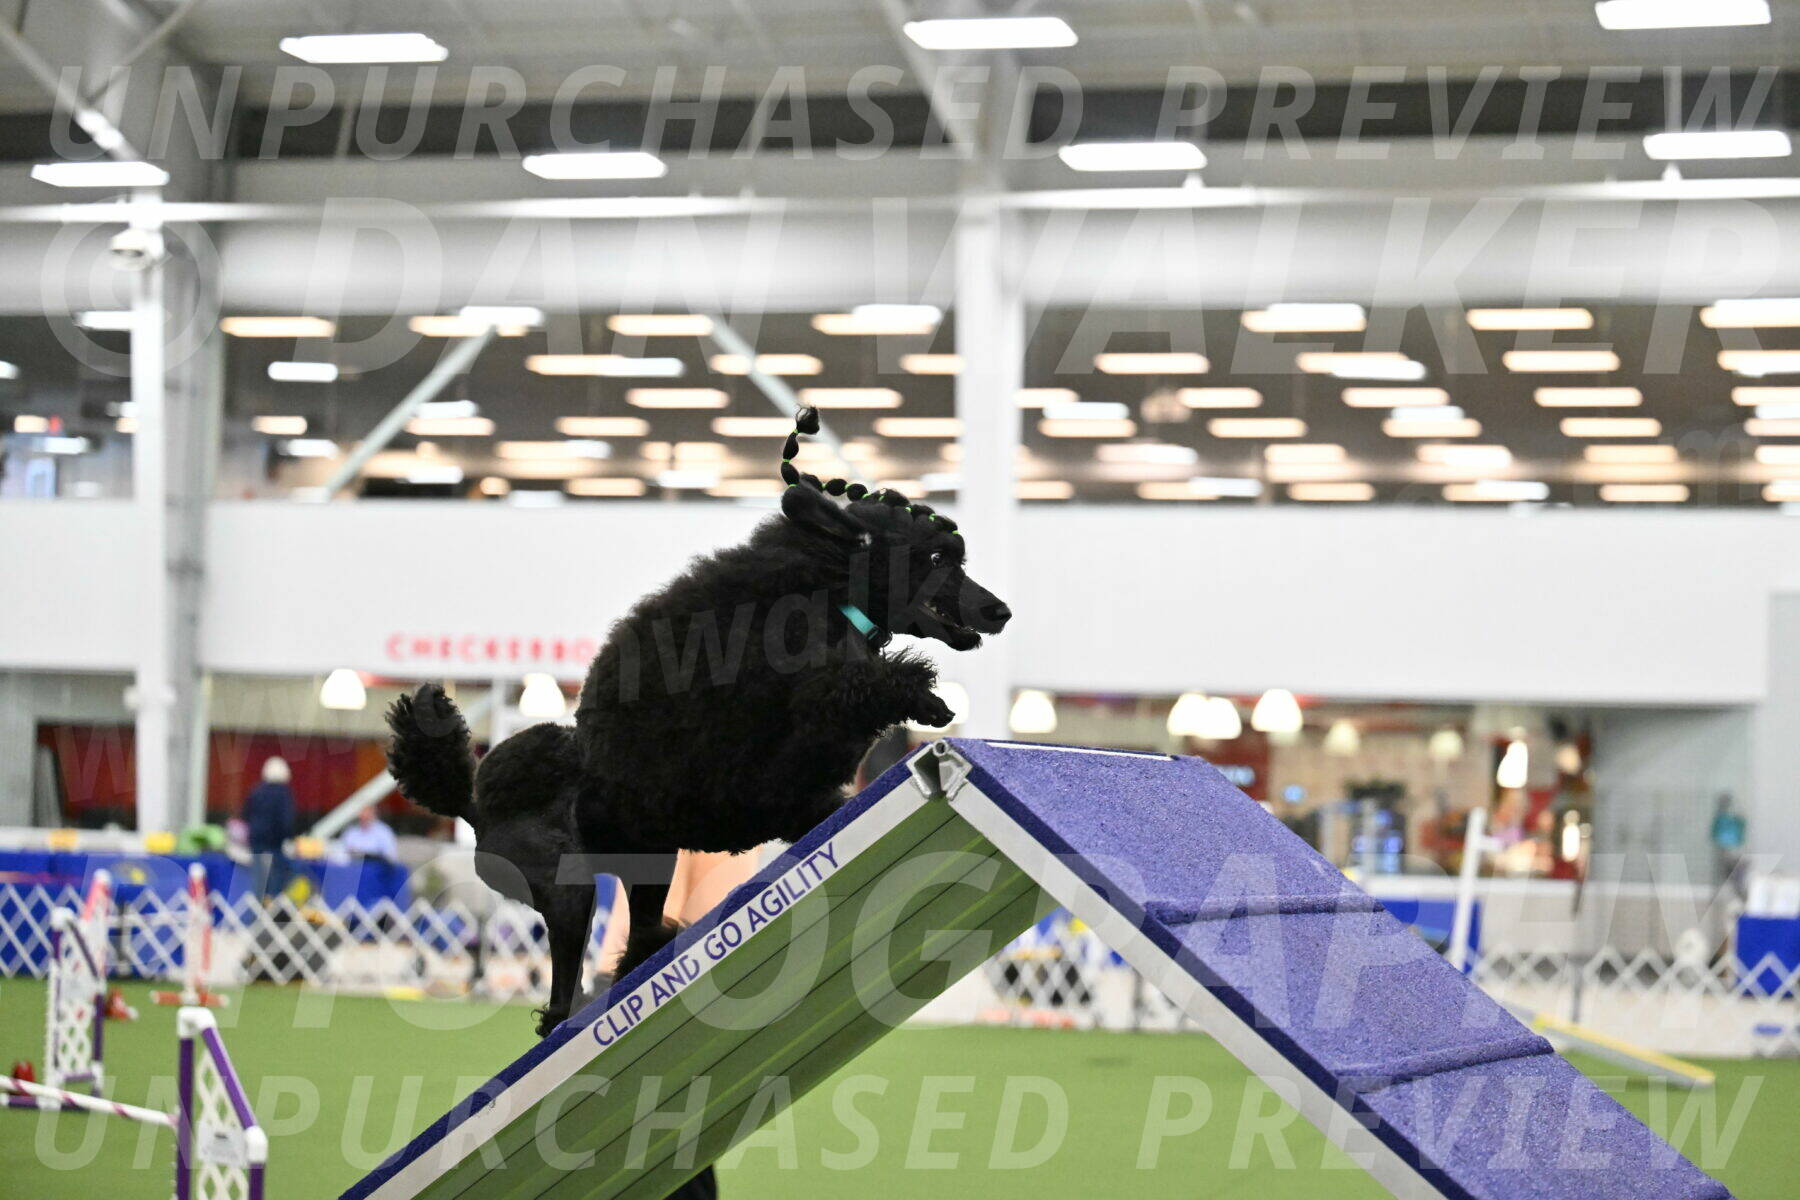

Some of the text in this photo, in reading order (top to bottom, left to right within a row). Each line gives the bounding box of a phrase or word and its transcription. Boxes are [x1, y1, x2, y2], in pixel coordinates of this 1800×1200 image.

[592, 841, 840, 1046] CLIP AND GO AGILITY
